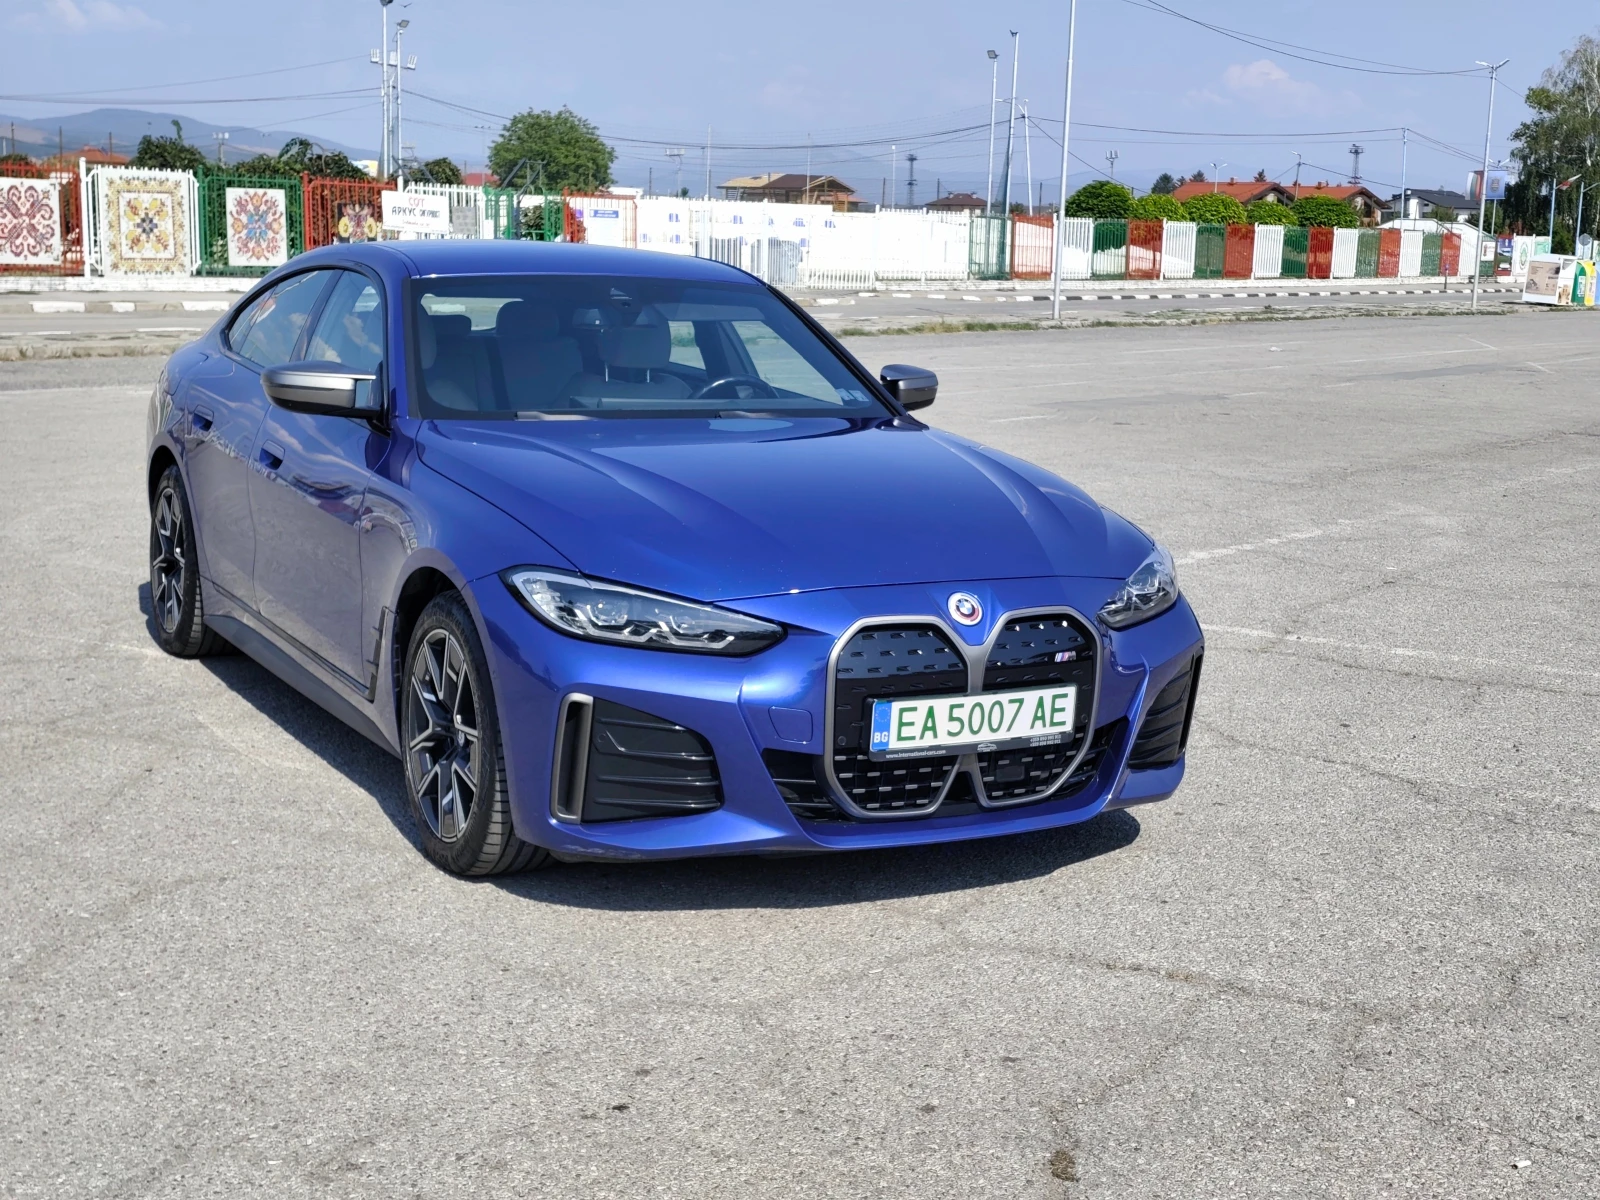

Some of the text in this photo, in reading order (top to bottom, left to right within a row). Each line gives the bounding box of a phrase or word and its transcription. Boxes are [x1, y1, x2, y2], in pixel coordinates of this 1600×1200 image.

[392, 206, 416, 217] АРКУС
[896, 693, 1069, 742] EA 5007 AE
[873, 732, 889, 743] BG
